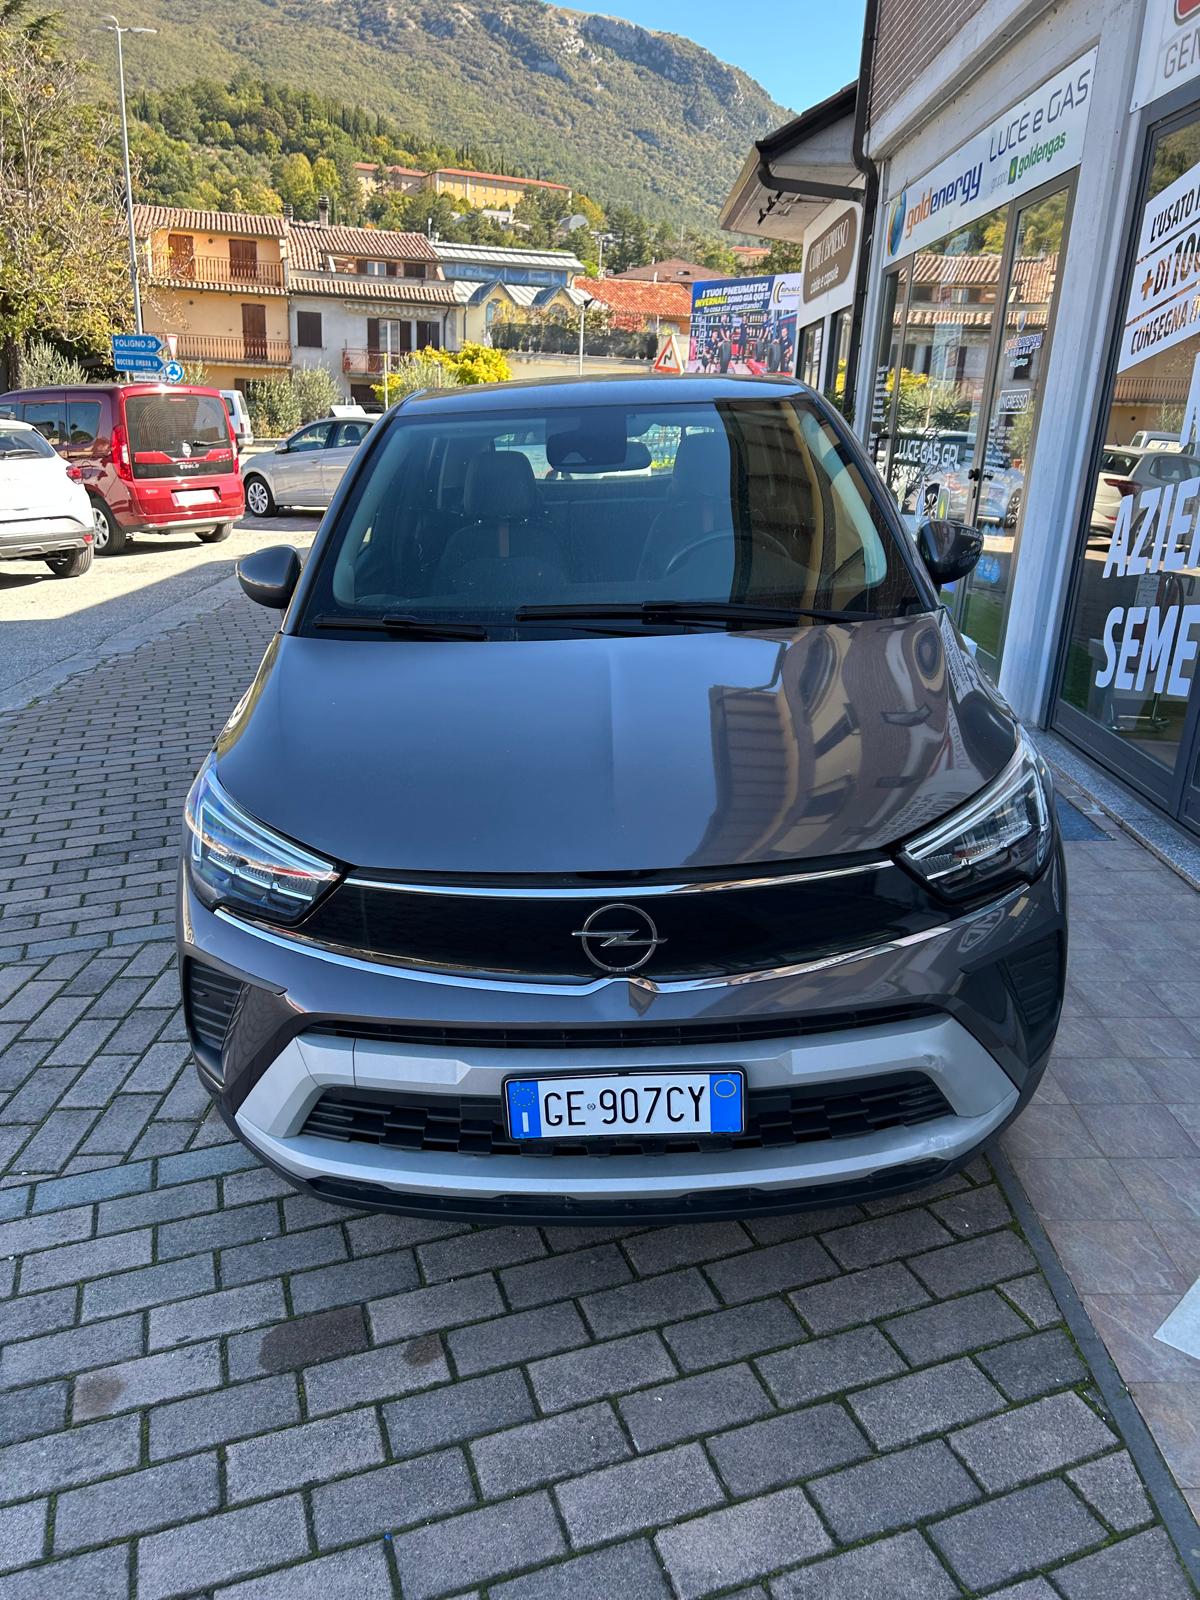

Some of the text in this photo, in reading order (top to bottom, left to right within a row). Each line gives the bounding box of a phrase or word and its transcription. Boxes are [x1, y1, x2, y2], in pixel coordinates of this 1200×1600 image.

[989, 69, 1091, 163] LUCE e GAS
[1017, 131, 1066, 179] goldengas
[904, 162, 983, 239] goldenergy
[1150, 188, 1195, 243] L'USATO
[695, 296, 727, 307] INVERNALI
[727, 294, 743, 304] SONO
[753, 292, 764, 301] QUI
[702, 283, 769, 298] I TUOI PNEUMATICI
[721, 304, 732, 312] stai
[731, 302, 763, 312] aspettando?
[115, 339, 146, 348] FOLIGNO
[1131, 299, 1188, 355] CONSEGNA
[117, 358, 134, 366] NOCERA
[135, 359, 152, 367] UMBRA
[898, 439, 920, 462] LUCE
[920, 441, 941, 465] GAS
[942, 444, 960, 469] GPL
[1095, 604, 1200, 698] SEME
[543, 1090, 586, 1127] GE
[599, 1085, 706, 1126] 907CY
